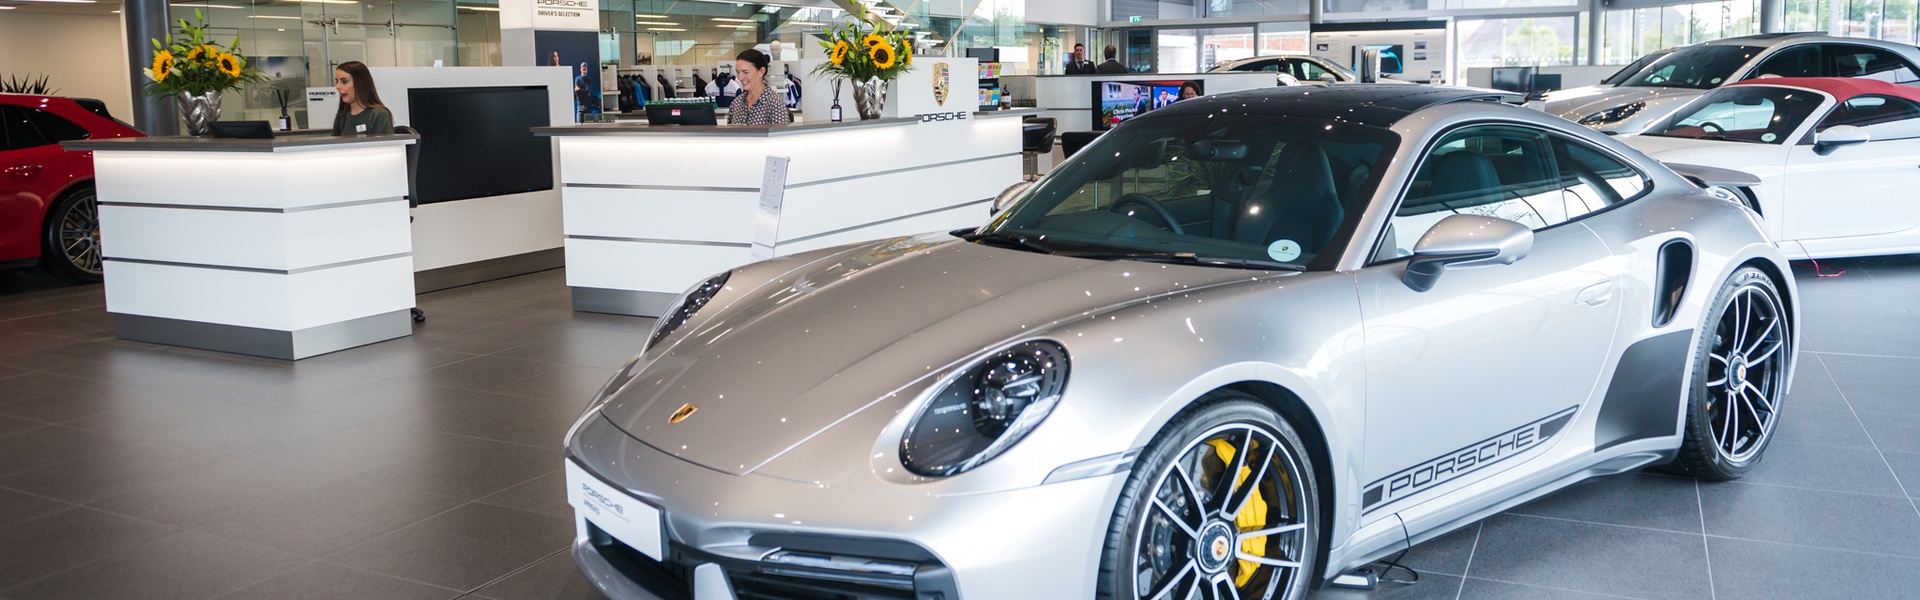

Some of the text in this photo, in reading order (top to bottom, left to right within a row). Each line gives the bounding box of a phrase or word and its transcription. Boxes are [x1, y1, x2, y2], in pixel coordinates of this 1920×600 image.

[538, 0, 588, 8] PORSCHE
[1743, 272, 1772, 287] P ZERO
[1389, 427, 1535, 498] PORSCHE
